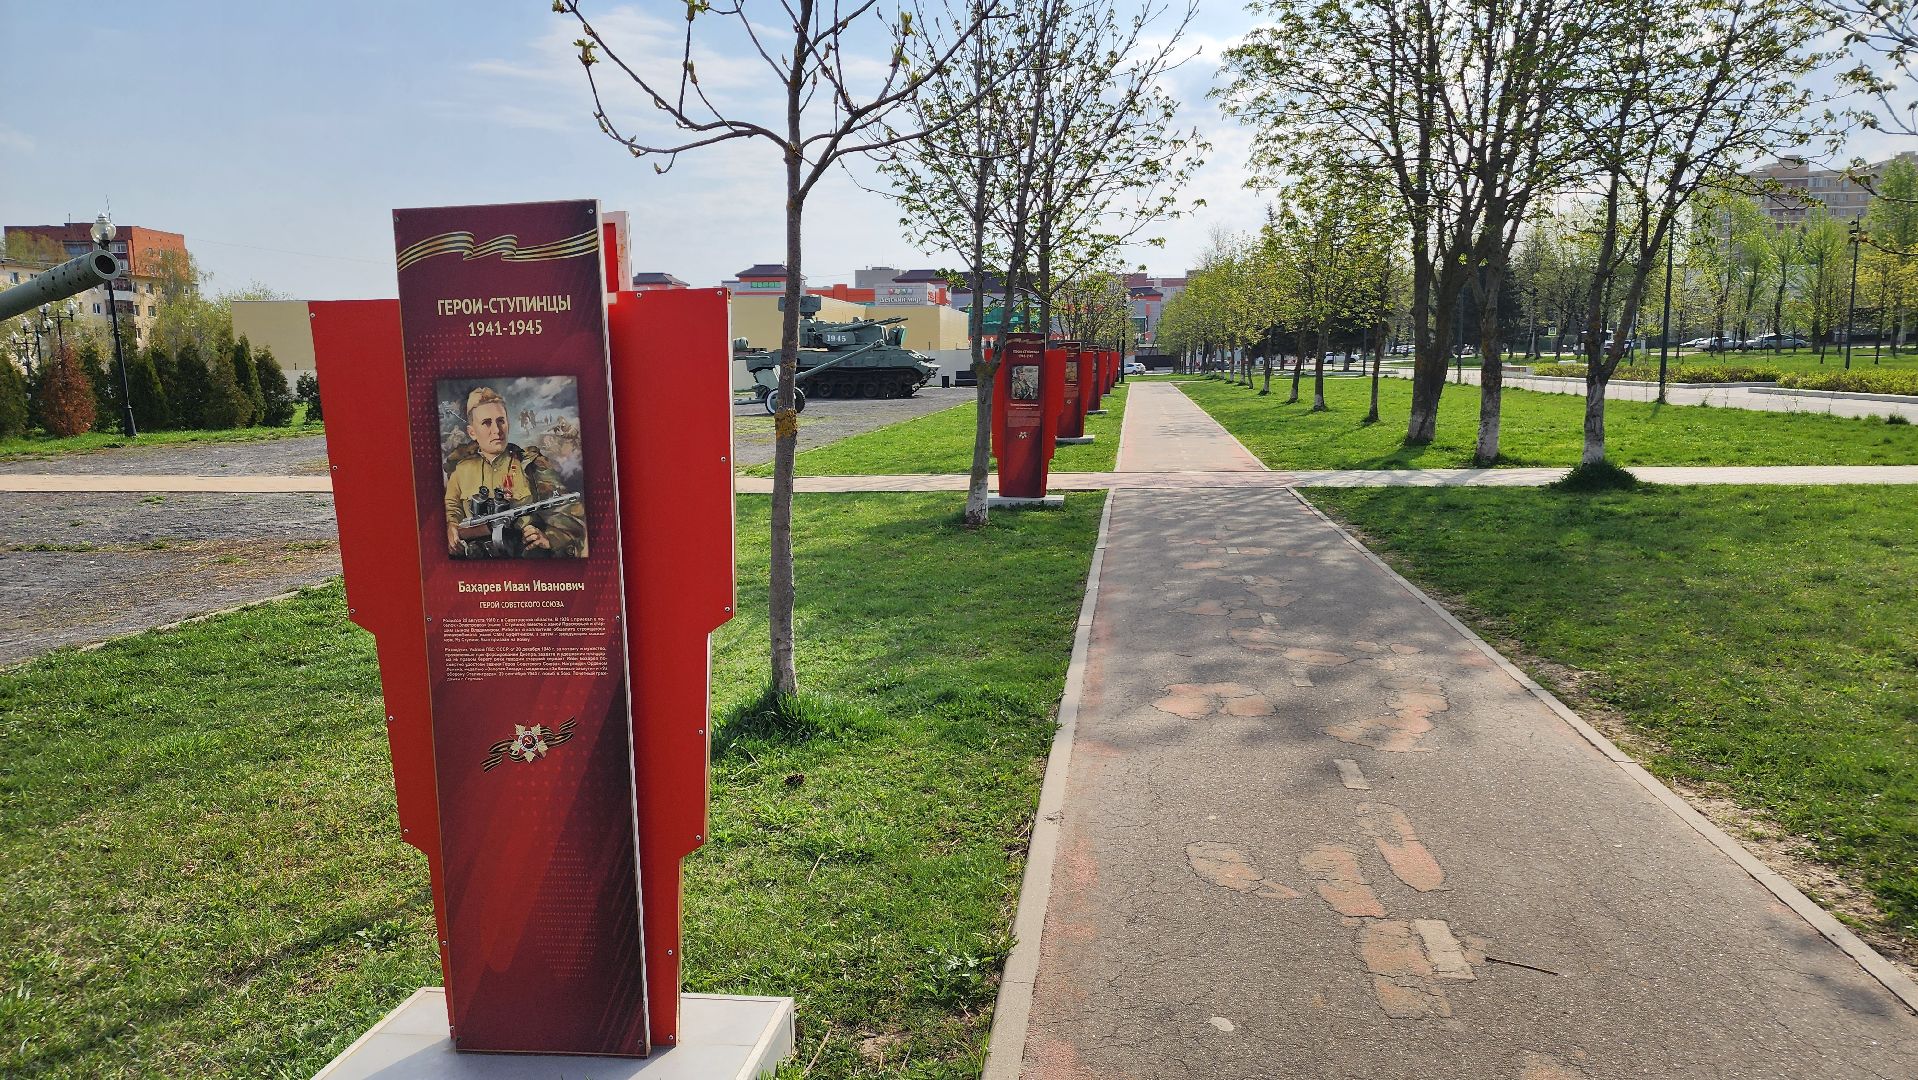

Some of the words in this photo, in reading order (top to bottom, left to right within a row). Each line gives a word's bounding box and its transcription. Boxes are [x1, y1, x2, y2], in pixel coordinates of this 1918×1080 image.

[437, 295, 571, 315] ГЕРОИ-СТУПИНЦЫ
[468, 319, 543, 337] 1941-1945
[826, 334, 847, 342] 1945
[458, 581, 502, 595] Бахарев
[503, 580, 531, 592] Иван
[533, 579, 585, 592] Иванович
[479, 600, 500, 609] ГЕРОЙ
[501, 600, 541, 609] СОВЕТСКОГО
[541, 600, 565, 608] СОЮЗА
